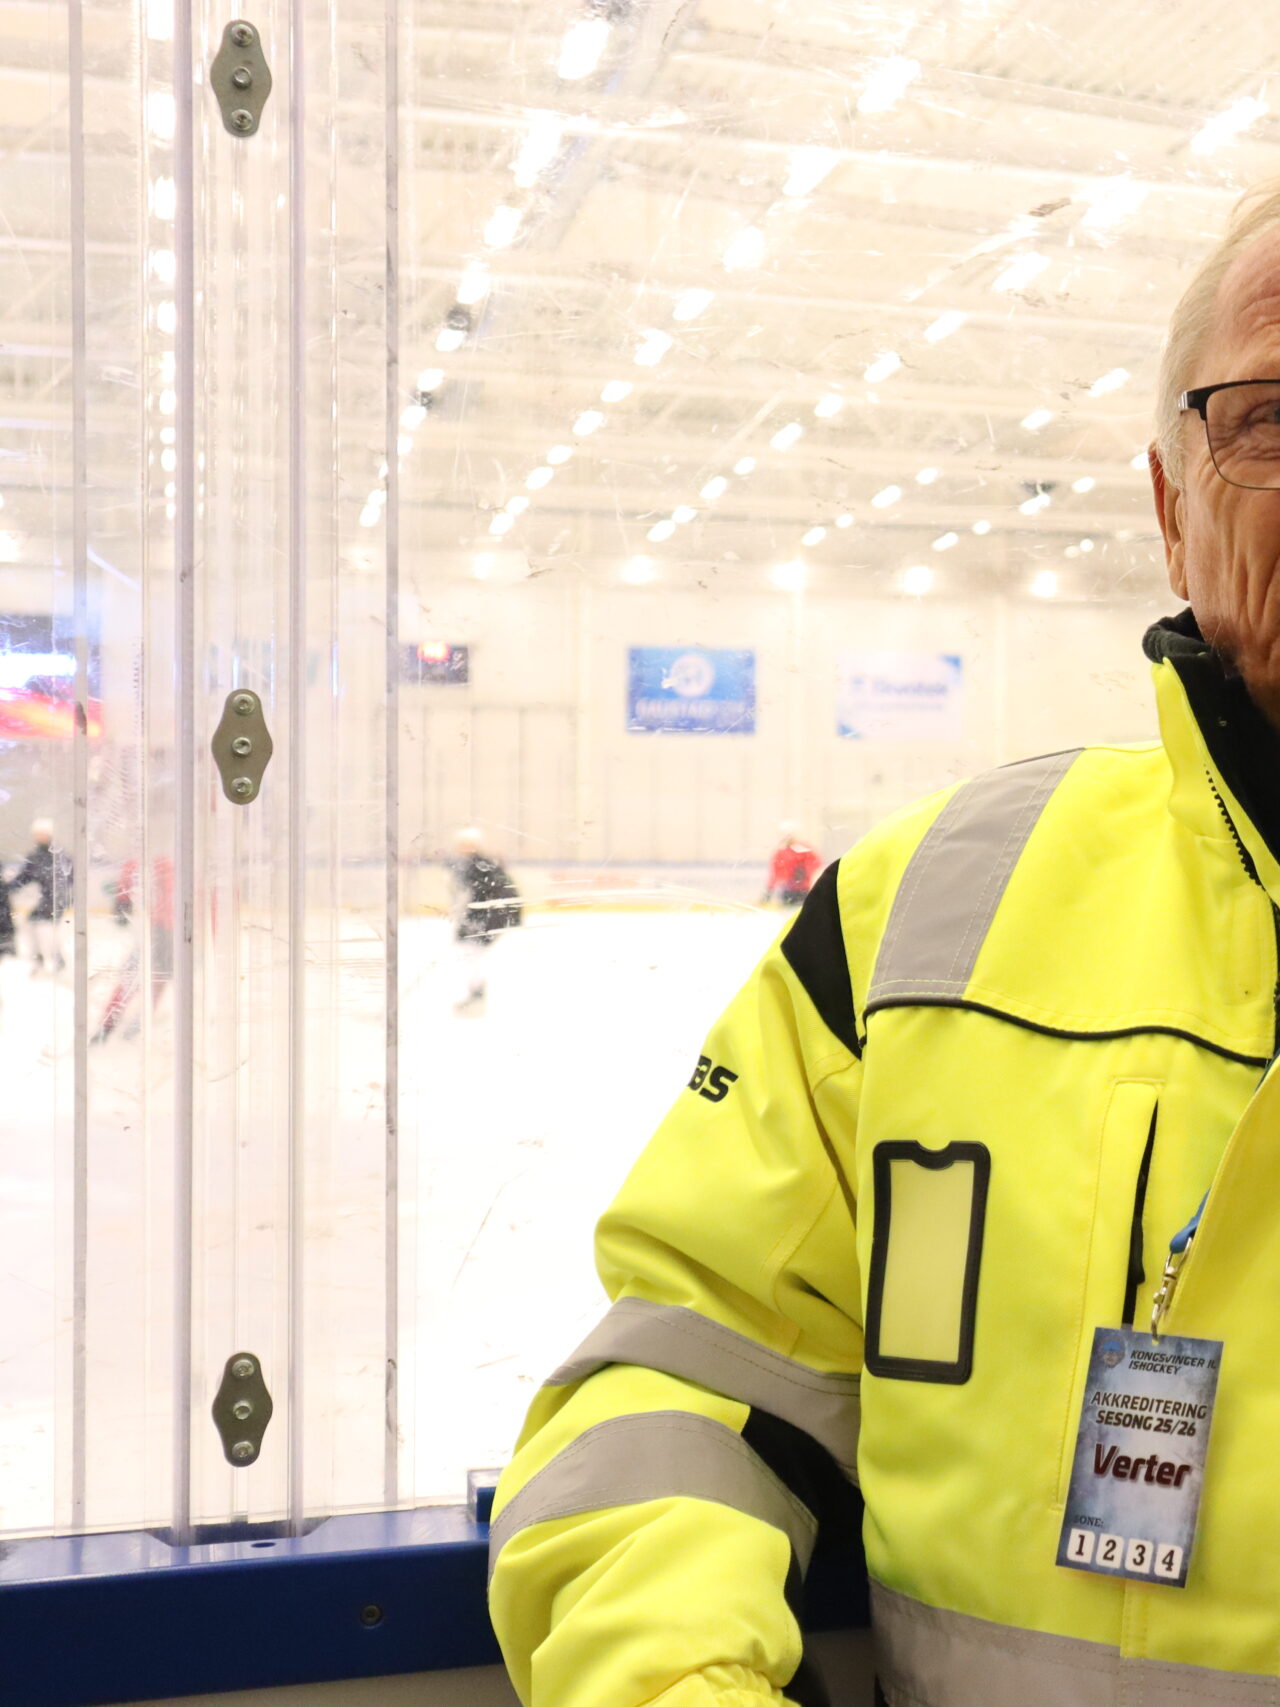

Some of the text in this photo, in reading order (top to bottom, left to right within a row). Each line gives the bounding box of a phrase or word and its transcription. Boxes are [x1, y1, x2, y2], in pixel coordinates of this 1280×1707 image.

[1128, 1360, 1181, 1375] ISHOCKEY
[1090, 1391, 1208, 1419] AKKREDITERING
[1095, 1410, 1196, 1437] SESONG 25/26
[1093, 1443, 1192, 1487] Verter
[1075, 1534, 1175, 1571] 1 2 3 4
